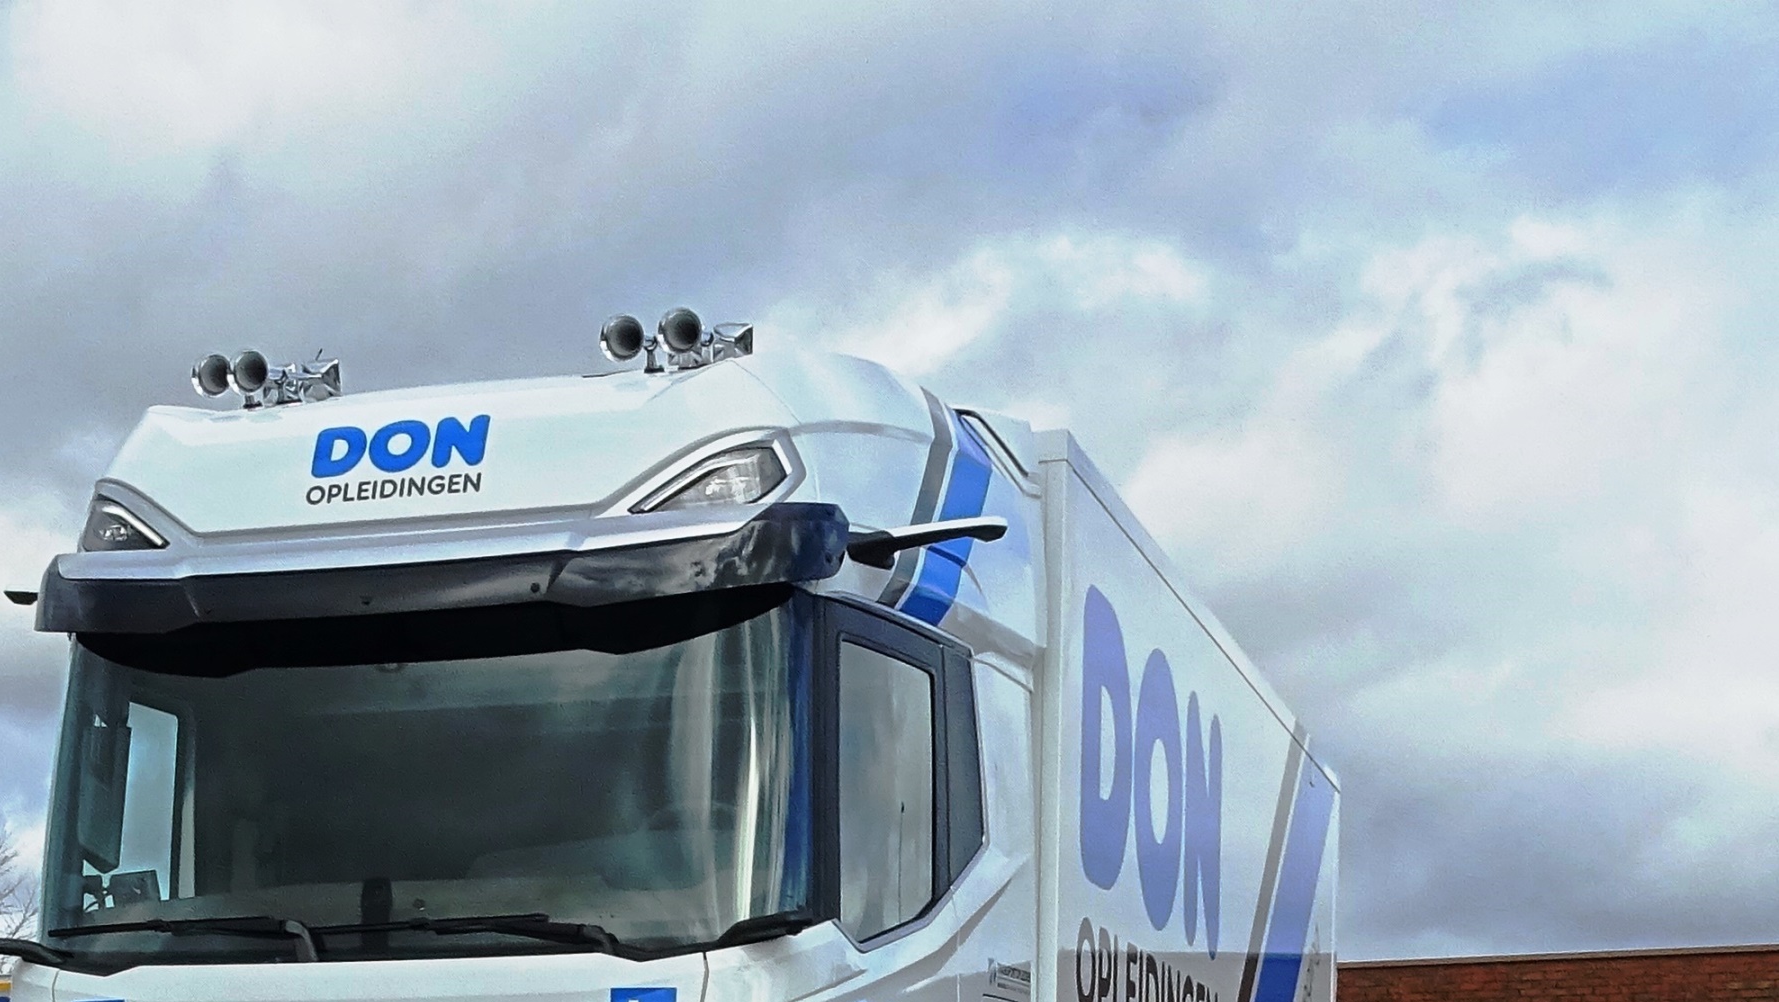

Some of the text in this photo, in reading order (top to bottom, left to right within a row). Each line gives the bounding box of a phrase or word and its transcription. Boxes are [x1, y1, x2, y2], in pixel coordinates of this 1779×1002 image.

[311, 414, 491, 478] DON
[306, 472, 482, 505] OPLEIDINGEN
[1079, 584, 1222, 961] DON
